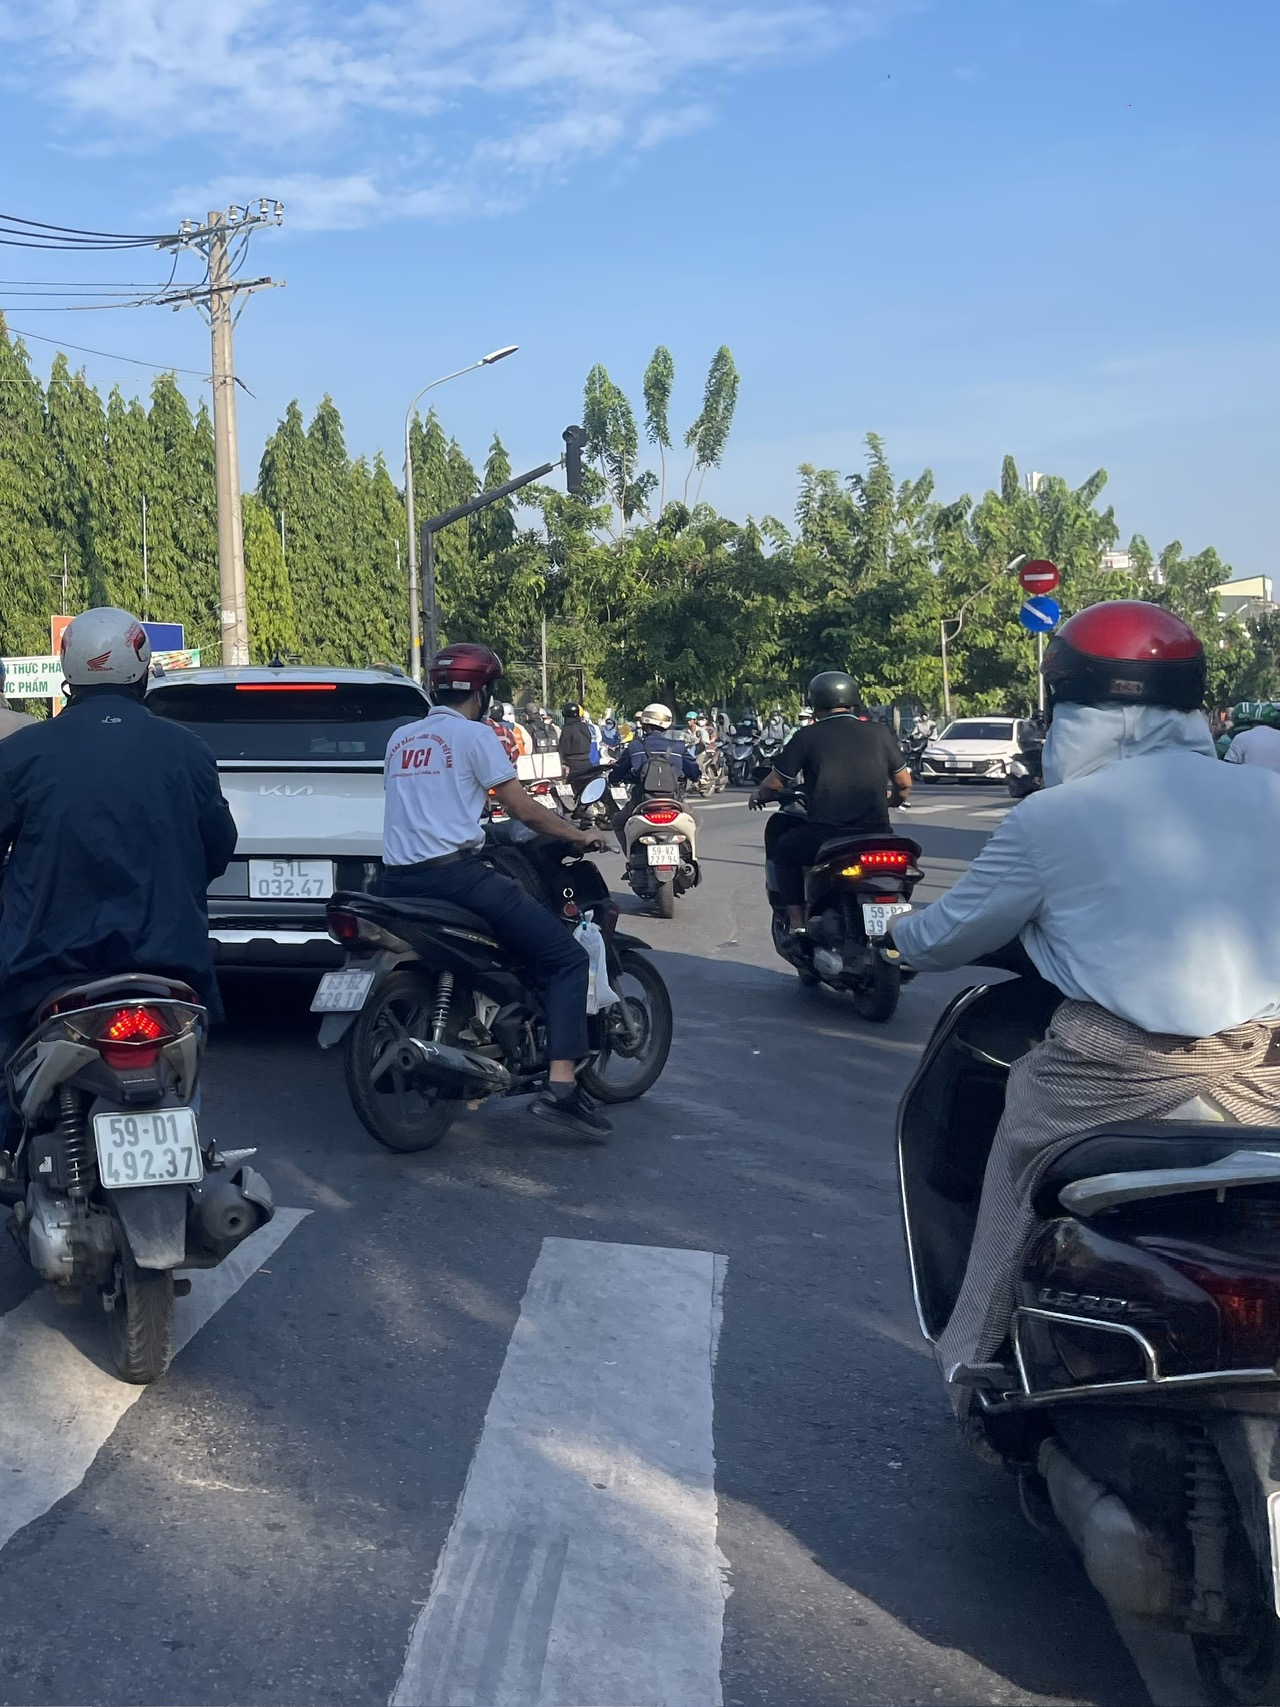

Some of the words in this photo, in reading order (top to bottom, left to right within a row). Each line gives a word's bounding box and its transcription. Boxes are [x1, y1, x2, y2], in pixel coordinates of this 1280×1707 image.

[13, 663, 38, 676] THỰC
[19, 677, 48, 693] PHẨM
[401, 747, 432, 769] VCI
[260, 784, 314, 796] KIA
[272, 861, 308, 877] 51L
[258, 879, 324, 896] 032.47
[109, 1114, 179, 1148] 59-D1
[107, 1147, 193, 1182] 492.37
